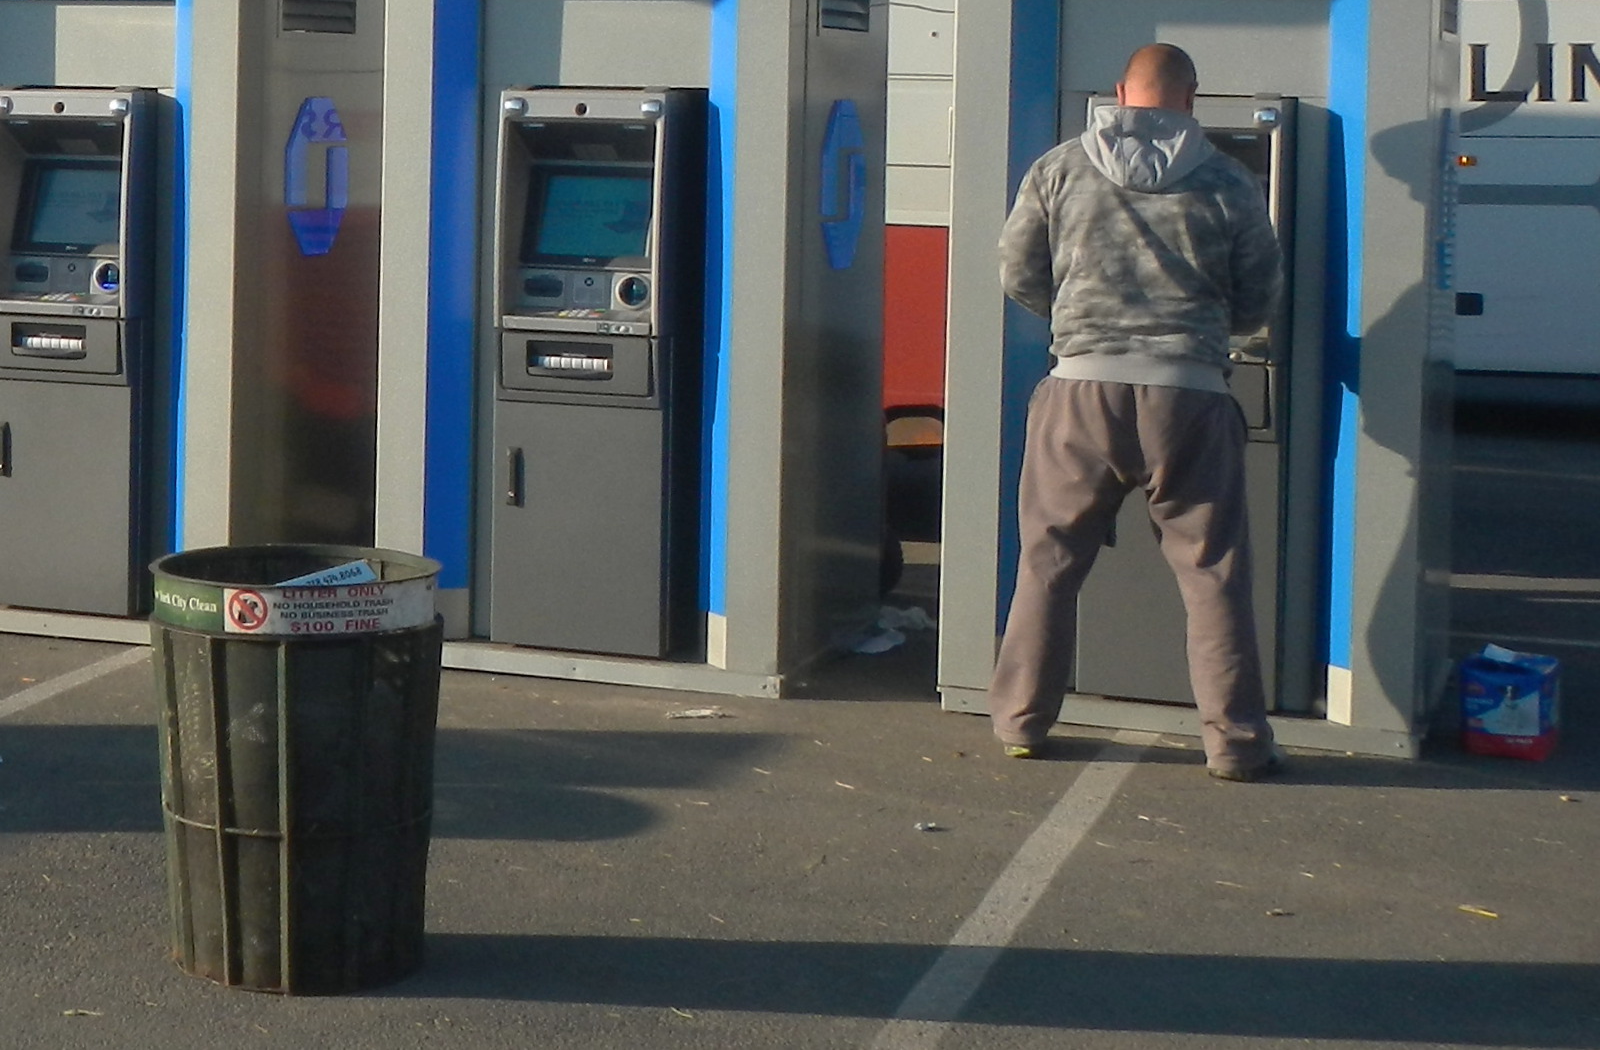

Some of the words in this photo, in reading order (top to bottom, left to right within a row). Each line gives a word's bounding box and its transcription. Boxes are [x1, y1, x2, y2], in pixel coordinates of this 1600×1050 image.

[282, 587, 337, 599] LITTER
[347, 584, 386, 597] ONLY
[172, 594, 187, 611] City
[189, 597, 217, 613] Clean
[273, 602, 290, 610] NO
[293, 600, 360, 610] HOUSEHOLD
[364, 598, 394, 607] TRASH
[280, 611, 297, 619] NO
[301, 610, 354, 619] BUSINESS
[358, 608, 389, 617] TRASH
[290, 621, 334, 633] $100
[345, 618, 381, 631] FINE
